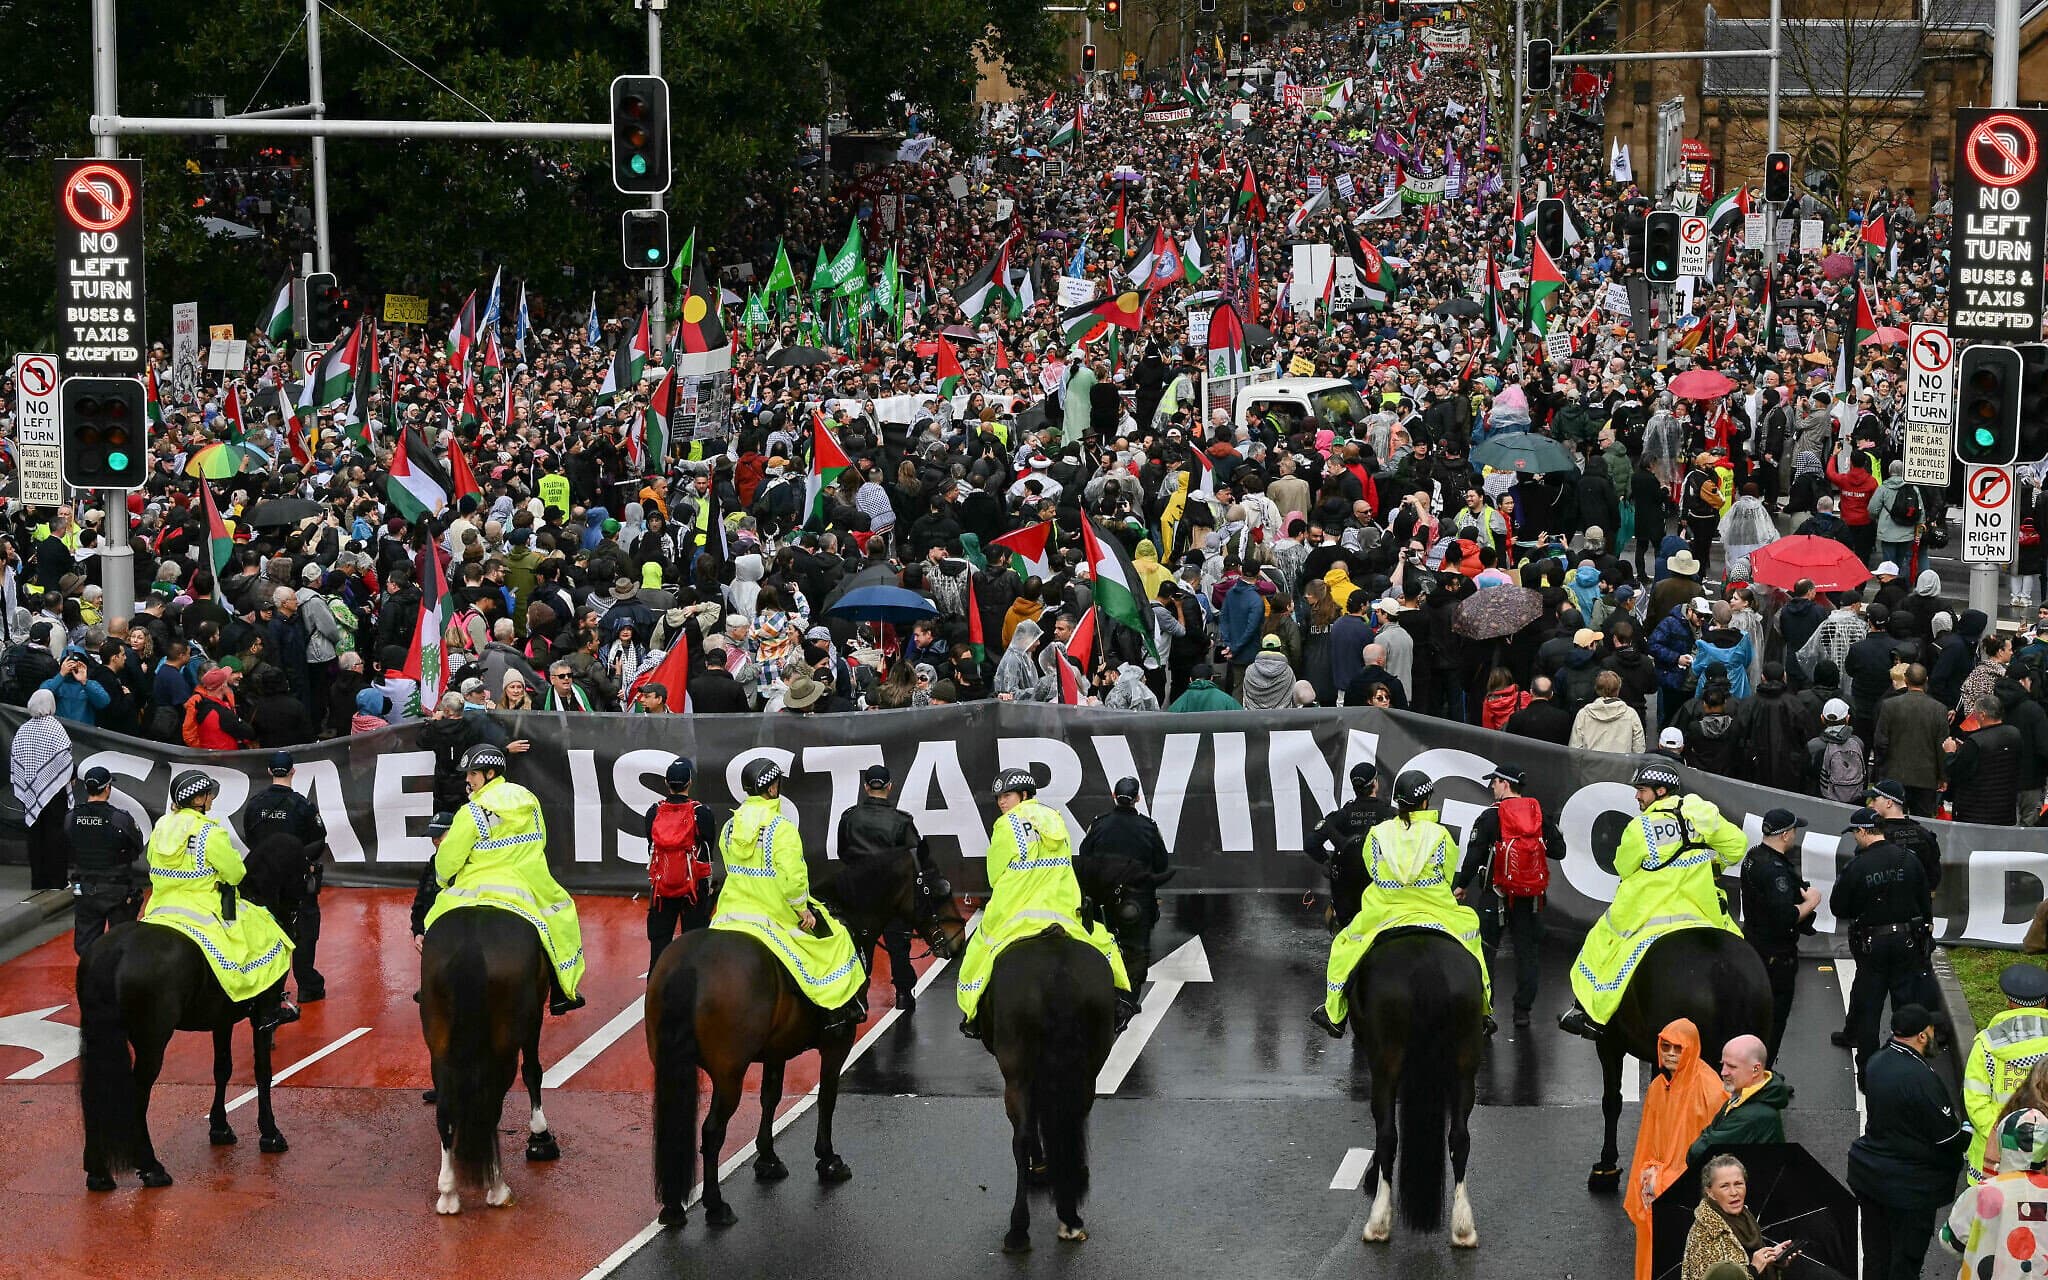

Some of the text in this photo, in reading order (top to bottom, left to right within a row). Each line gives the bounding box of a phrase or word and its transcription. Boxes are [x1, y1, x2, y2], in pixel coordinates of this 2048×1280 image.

[1145, 108, 1189, 120] PALESTINE
[1413, 181, 1434, 190] FOR
[1979, 187, 2020, 211] NO
[1967, 214, 2031, 236] LEFT
[80, 232, 118, 253] NO
[1685, 245, 1701, 255] NO
[1964, 239, 2032, 261] TURN
[1681, 256, 1704, 264] RIGHT
[70, 258, 129, 276] LEFT
[1960, 269, 2034, 286] BUSES &
[70, 281, 132, 299] TURN
[1966, 290, 2025, 307] TAXIS
[67, 307, 136, 322] BUSES &
[386, 309, 426, 320] GENOCIDE
[1955, 311, 2034, 328] EXCEPTED
[73, 327, 129, 342] TAXIS
[65, 346, 139, 361] EXCEPTED
[1919, 374, 1942, 389] NO
[1914, 391, 1946, 403] LEFT
[26, 401, 48, 414] NO
[1912, 406, 1947, 419] TURN
[24, 418, 52, 427] LEFT
[24, 431, 54, 441] TURN
[1911, 435, 1924, 444] HIRE
[1909, 446, 1946, 457] MOTORBIKES
[25, 460, 37, 468] HIRE
[1908, 458, 1945, 469] & BICYCLES
[24, 470, 58, 479] MOTORBIKES
[1908, 469, 1945, 480] EXCEPTED
[25, 481, 58, 490] & BICYCLES
[24, 491, 59, 501] EXCEPTED
[1975, 512, 2002, 527] NO
[1968, 531, 2007, 542] RIGHT
[1970, 545, 2005, 556] TURN
[568, 749, 684, 863] IS
[726, 729, 1498, 872] STARVING
[1865, 868, 1905, 888] POLICE
